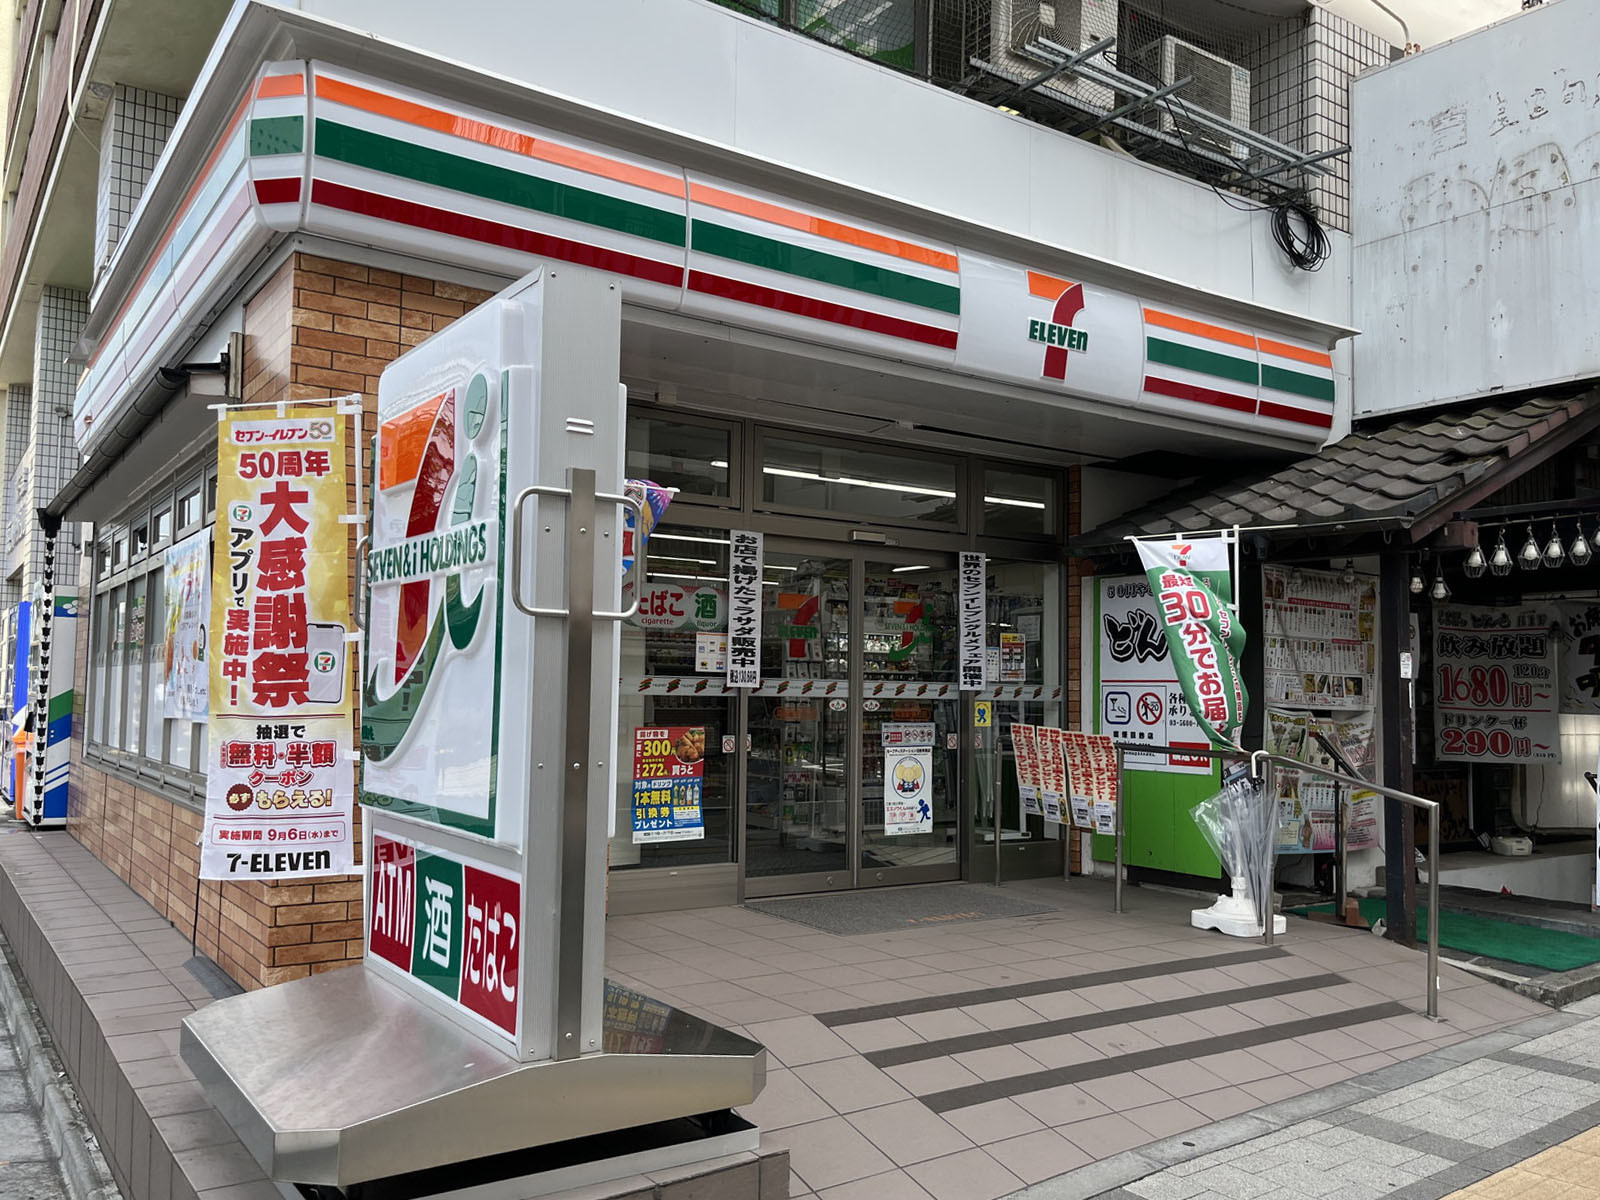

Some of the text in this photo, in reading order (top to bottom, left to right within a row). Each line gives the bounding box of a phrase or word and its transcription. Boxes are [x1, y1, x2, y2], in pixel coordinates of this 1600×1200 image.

[238, 449, 331, 480] 50周年
[420, 522, 487, 571] HOLDINGS
[252, 481, 310, 708] 大感謝祭
[694, 592, 718, 620] 酒
[641, 617, 675, 626] cigarette
[696, 620, 717, 629] liquor
[1437, 632, 1548, 659] 飲み放題
[256, 724, 306, 739] 抽選で
[672, 764, 694, 776] 買うと
[249, 769, 314, 787] クーポン
[228, 791, 251, 805] 必ず
[634, 790, 672, 805] 1本無料
[635, 807, 671, 819] 引換券
[634, 819, 673, 829] プレゼント
[218, 828, 263, 841] 実施期間
[374, 860, 411, 947] ATM
[422, 876, 454, 969] 酒
